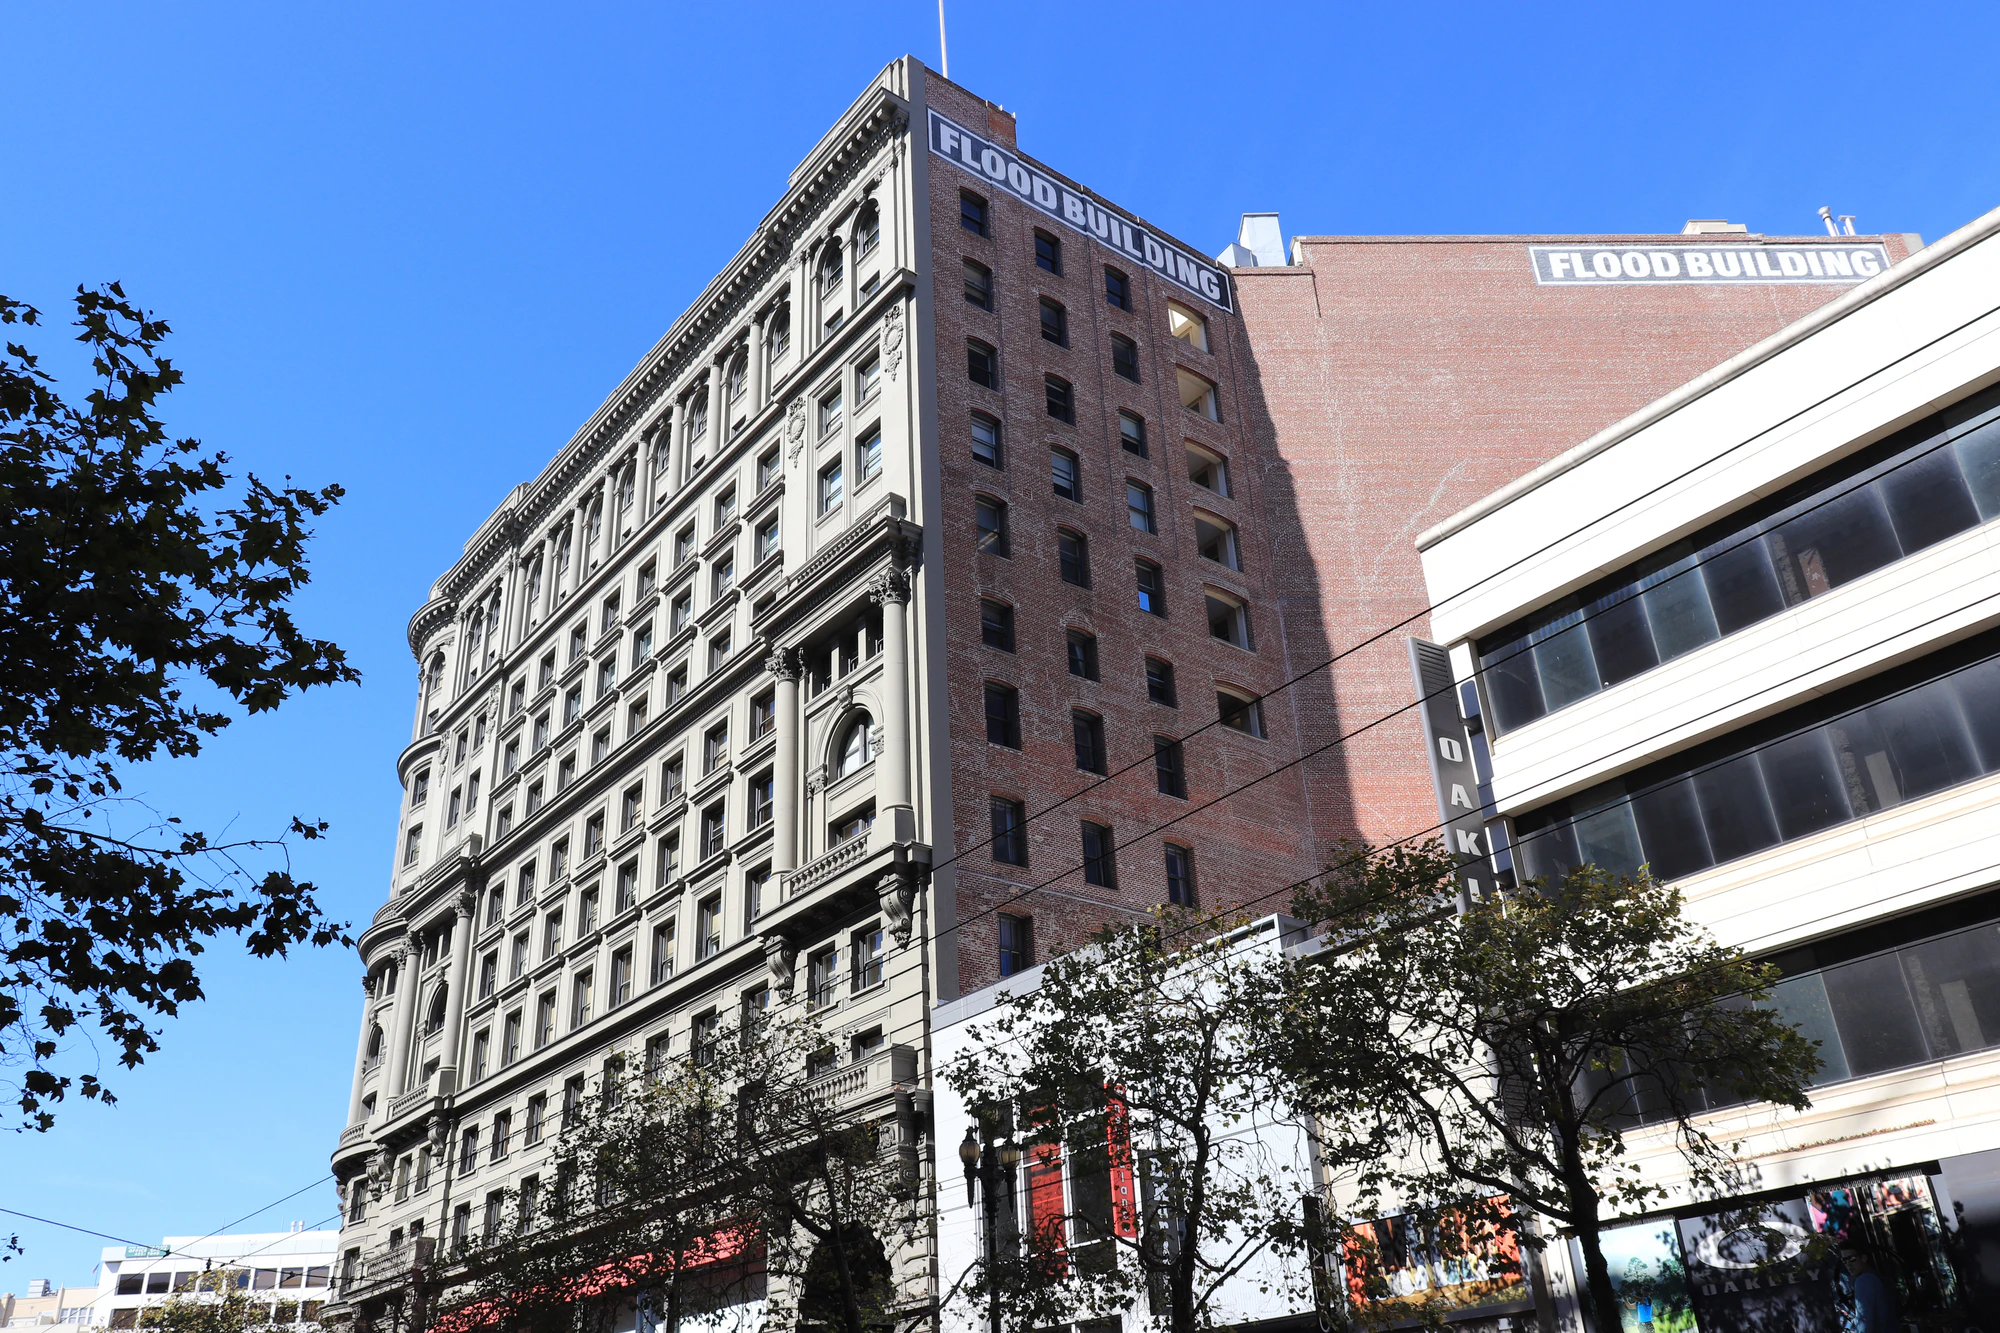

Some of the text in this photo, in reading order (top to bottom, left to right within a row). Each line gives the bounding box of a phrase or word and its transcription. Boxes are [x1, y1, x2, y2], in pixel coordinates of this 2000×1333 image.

[939, 121, 1221, 301] FLOOD BUILDING
[1548, 250, 1882, 279] FLOOD BUILDING
[1702, 1268, 1820, 1297] OAKLEY
